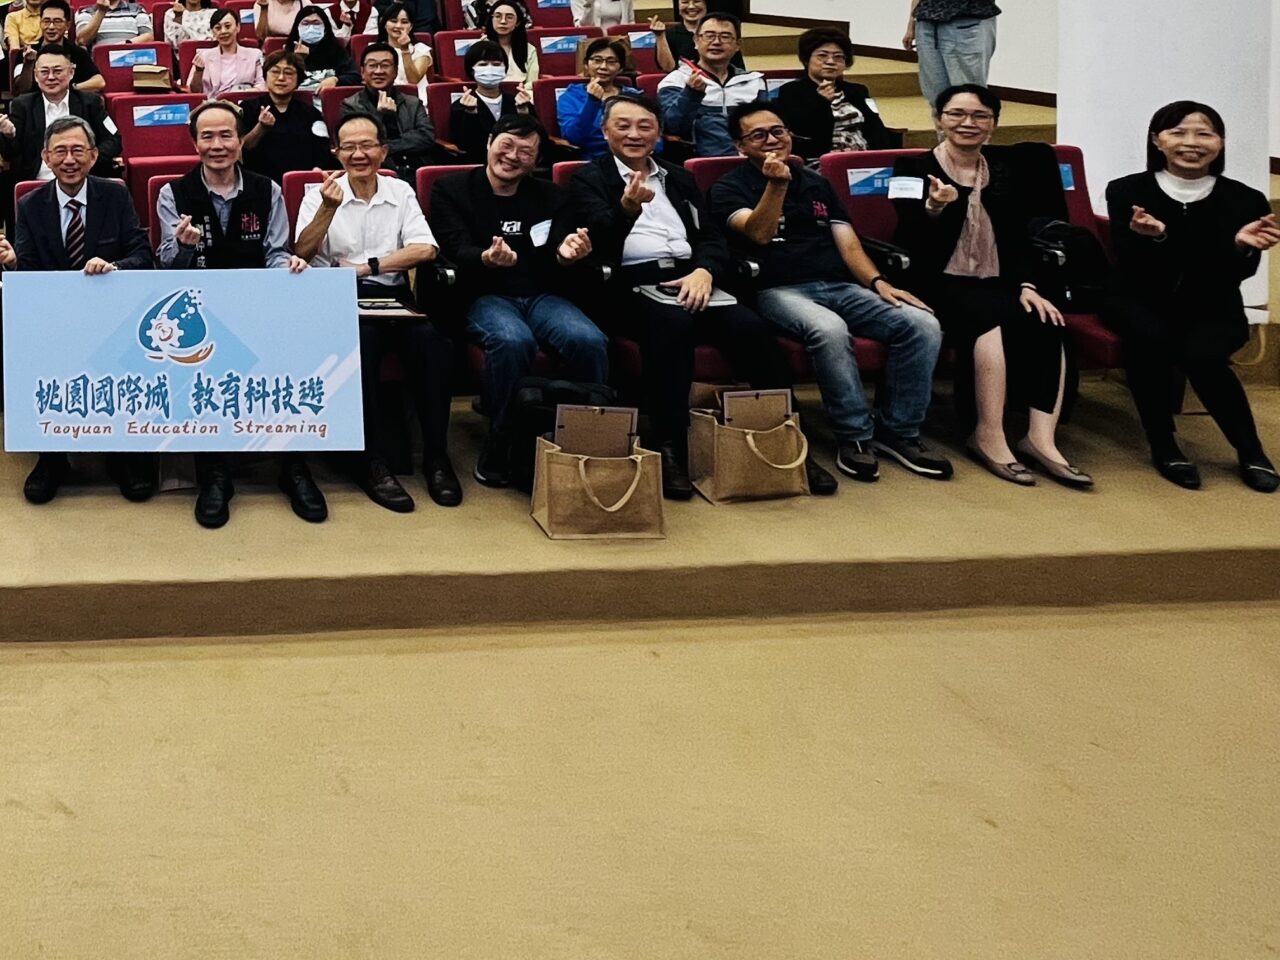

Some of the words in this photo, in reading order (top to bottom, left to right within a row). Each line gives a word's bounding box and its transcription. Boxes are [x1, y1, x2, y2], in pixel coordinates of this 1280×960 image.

[35, 373, 171, 419] 桃園國際城
[192, 371, 326, 420] 教育科技遊
[39, 421, 112, 438] Taoyuan
[127, 420, 219, 435] Education
[233, 420, 328, 438] Streaming
